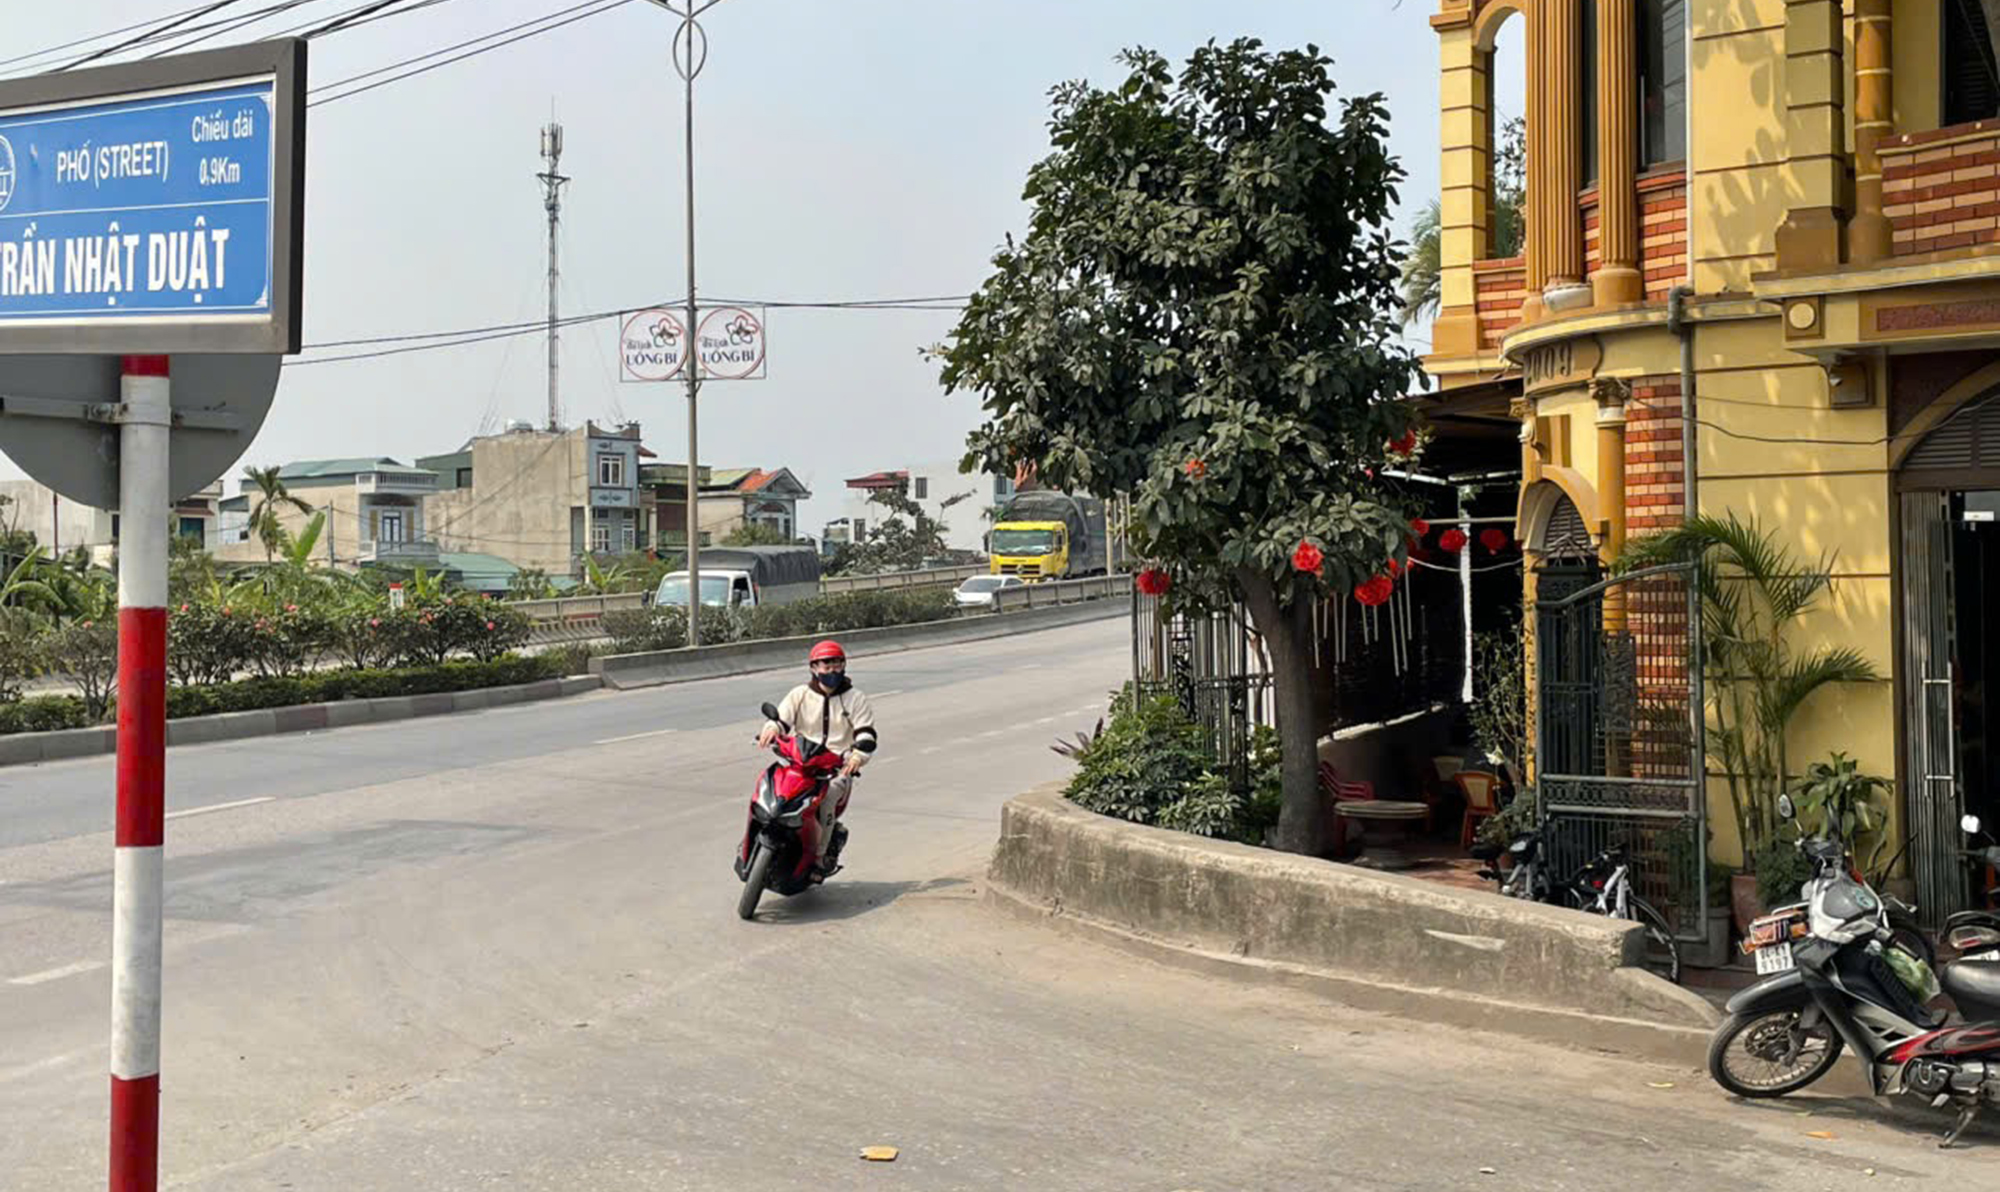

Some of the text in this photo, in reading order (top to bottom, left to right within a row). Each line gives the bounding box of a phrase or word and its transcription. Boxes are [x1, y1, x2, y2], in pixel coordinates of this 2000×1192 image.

[233, 109, 254, 139] dài
[57, 139, 169, 189] PHỐ (STREET)
[0, 215, 230, 305] RẦN NHẬT DUẬT
